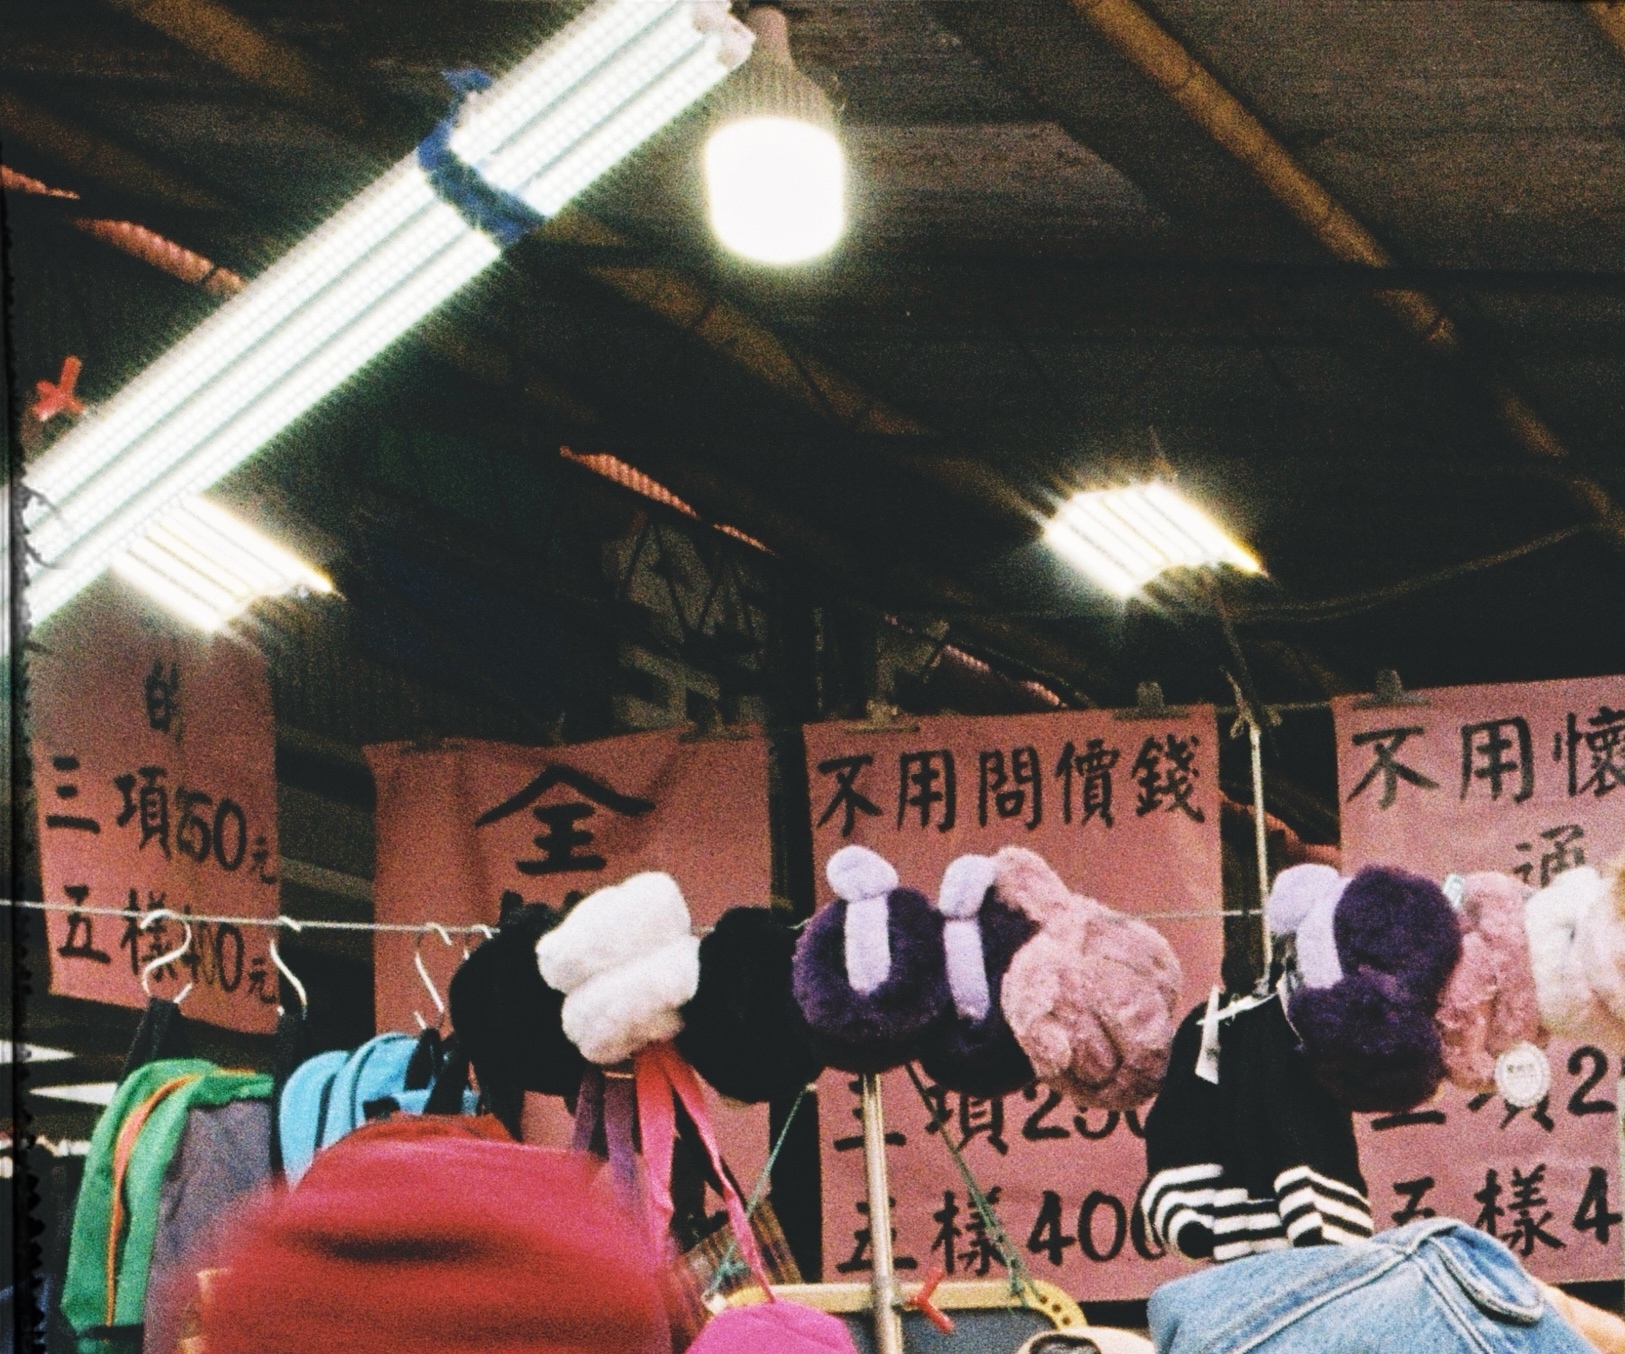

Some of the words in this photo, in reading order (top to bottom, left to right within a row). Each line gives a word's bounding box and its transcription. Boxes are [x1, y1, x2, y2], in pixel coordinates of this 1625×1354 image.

[475, 765, 656, 874] 全
[817, 734, 1206, 837] 不用問價錢
